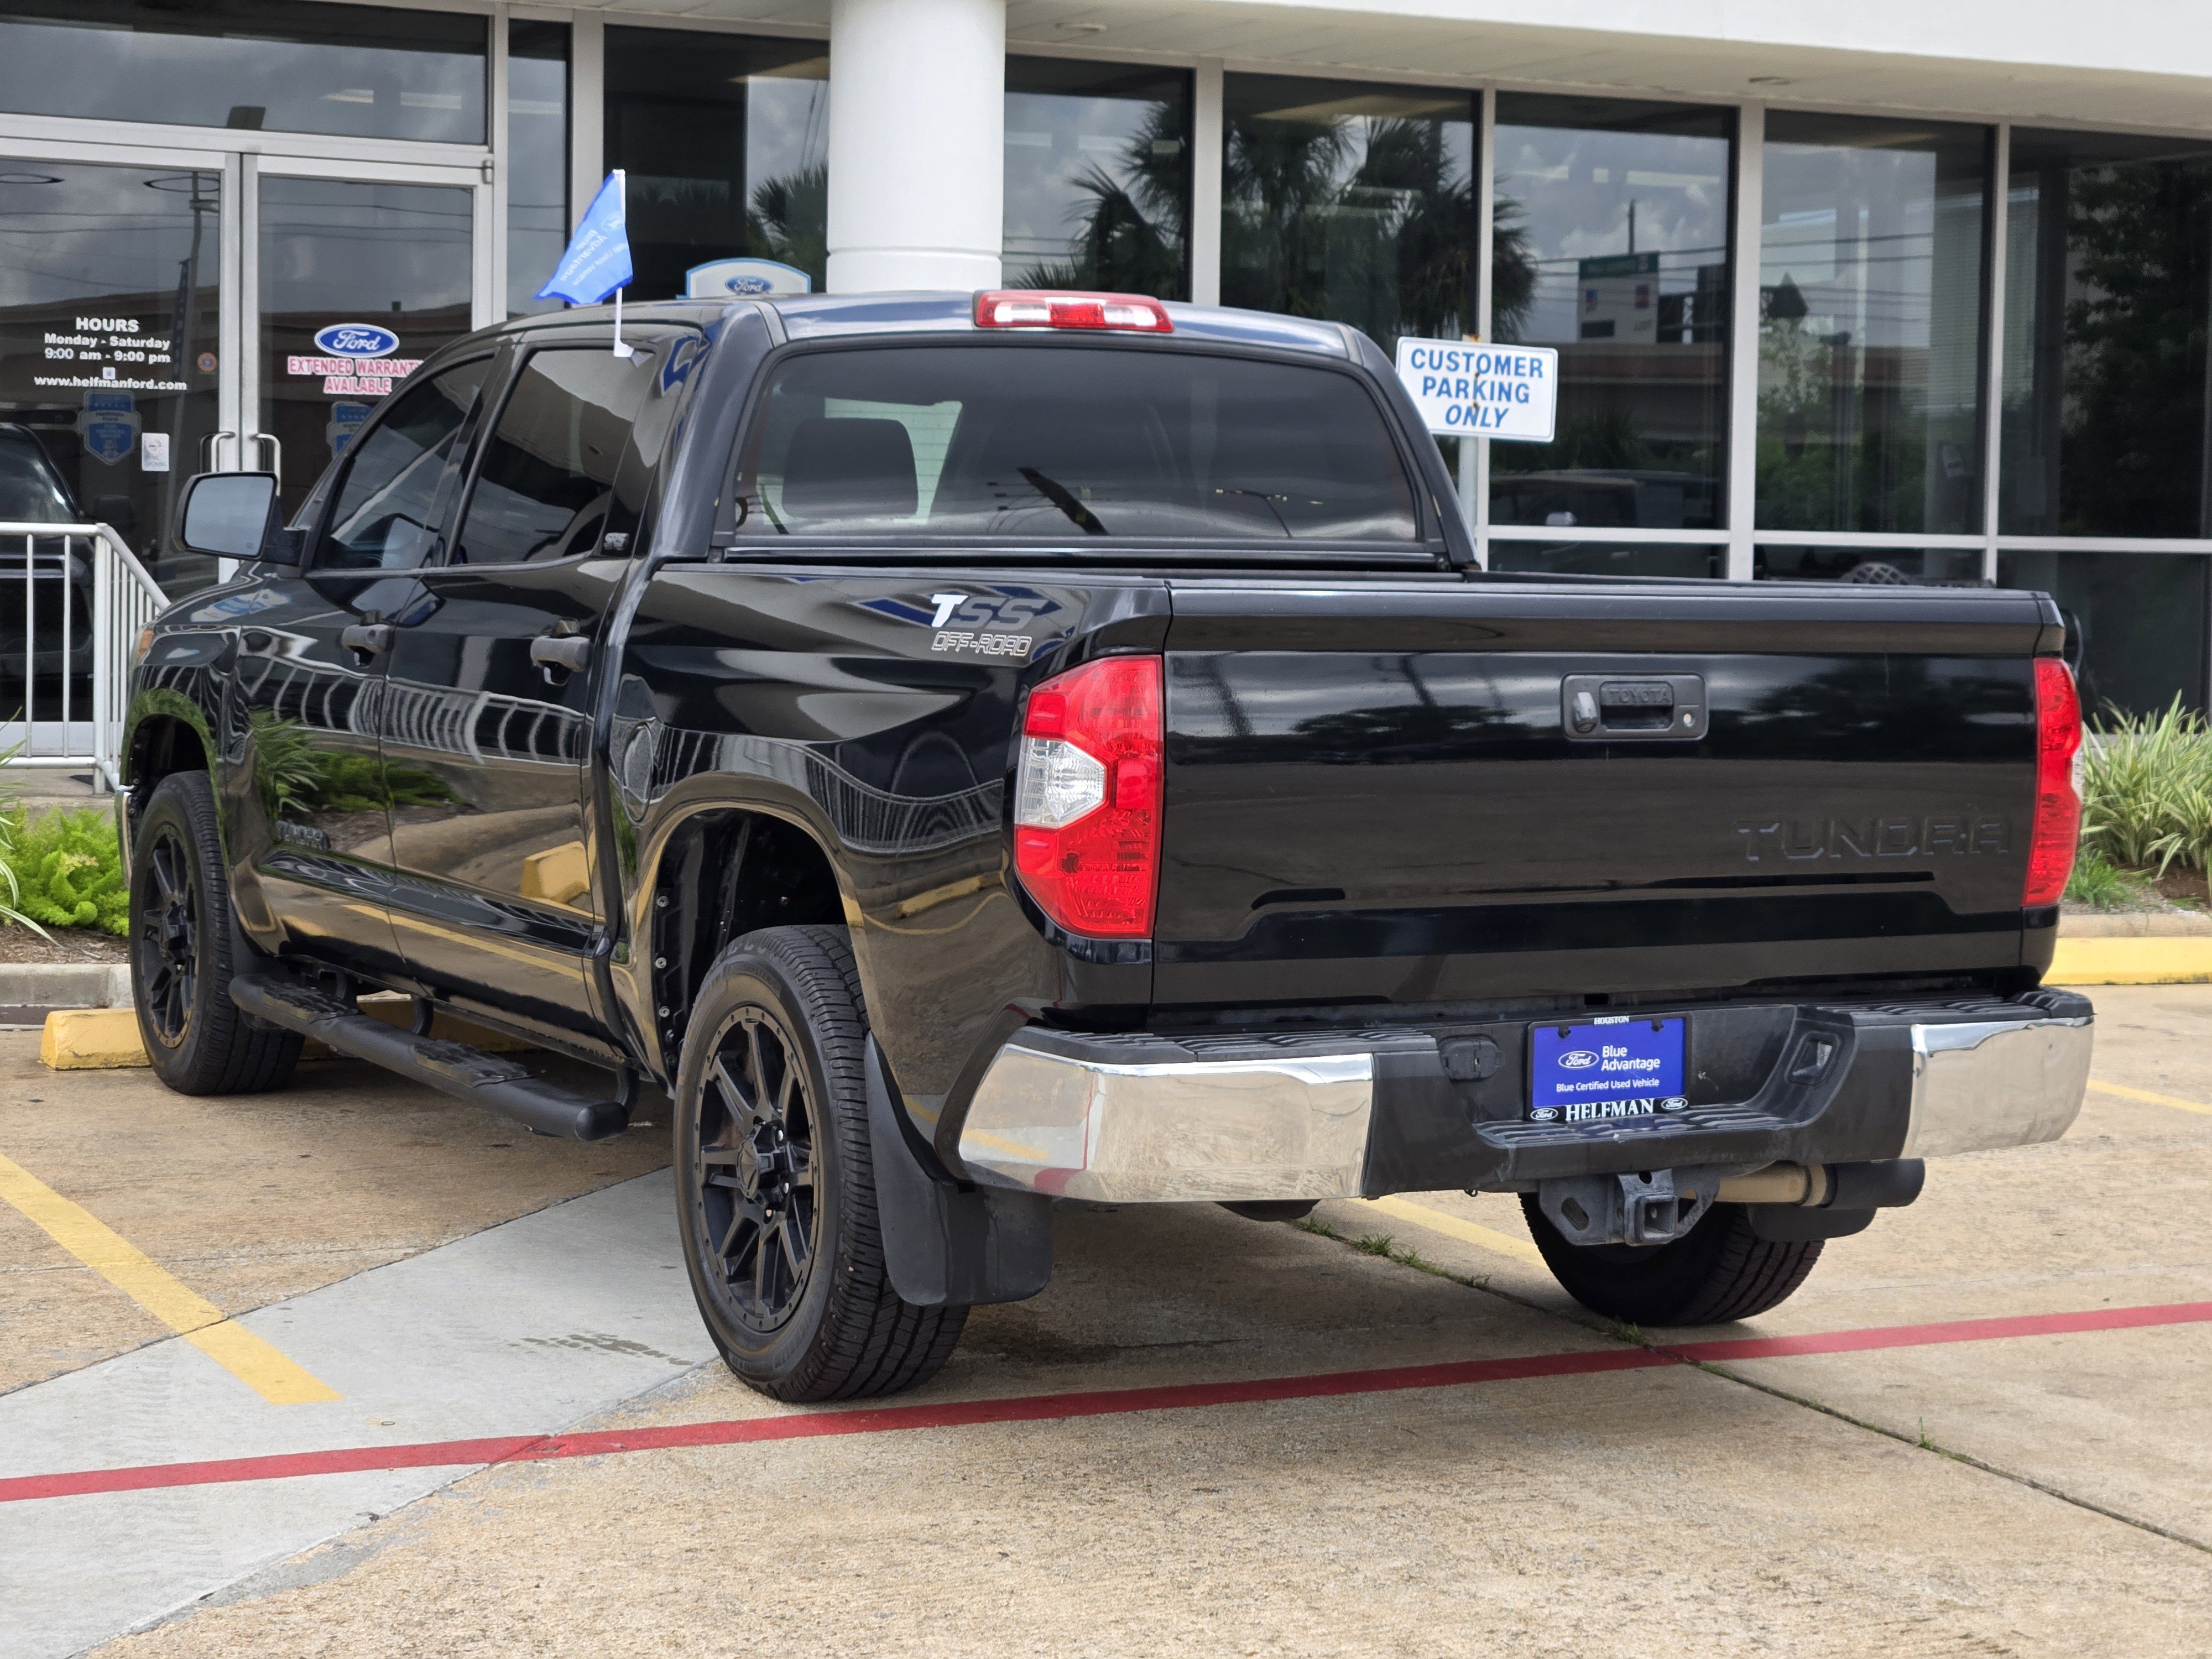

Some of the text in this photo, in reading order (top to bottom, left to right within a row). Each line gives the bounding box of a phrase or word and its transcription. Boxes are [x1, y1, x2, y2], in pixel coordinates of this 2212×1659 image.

[734, 278, 764, 292] Ford
[76, 317, 139, 332] HOURS
[44, 333, 97, 348] Monday
[110, 336, 170, 351] Saturday
[333, 330, 381, 350] Ford
[44, 348, 74, 359] 9:00
[80, 351, 101, 360] am
[114, 351, 144, 362] 9:00
[149, 353, 170, 364] pm
[1411, 348, 1543, 378] CUSTOMER
[289, 358, 419, 376] EXTENDED WARRANT
[325, 377, 392, 394] AVAILABLE
[1422, 376, 1530, 404] PARKING
[1445, 404, 1509, 428] ONLY
[931, 631, 1032, 656] OFF-ROAD
[1733, 816, 2010, 861] TUNDRA
[1594, 1016, 1630, 1025] HOUSTON
[1602, 1045, 1627, 1057] Blue
[1566, 1053, 1592, 1066] Ford
[1601, 1058, 1661, 1072] Advantage
[1556, 1078, 1660, 1092] Blue Certified Used Vehicle
[1565, 1098, 1655, 1121] HELFMAN
[1666, 1099, 1683, 1108] Ford
[1535, 1110, 1553, 1119] Ford
